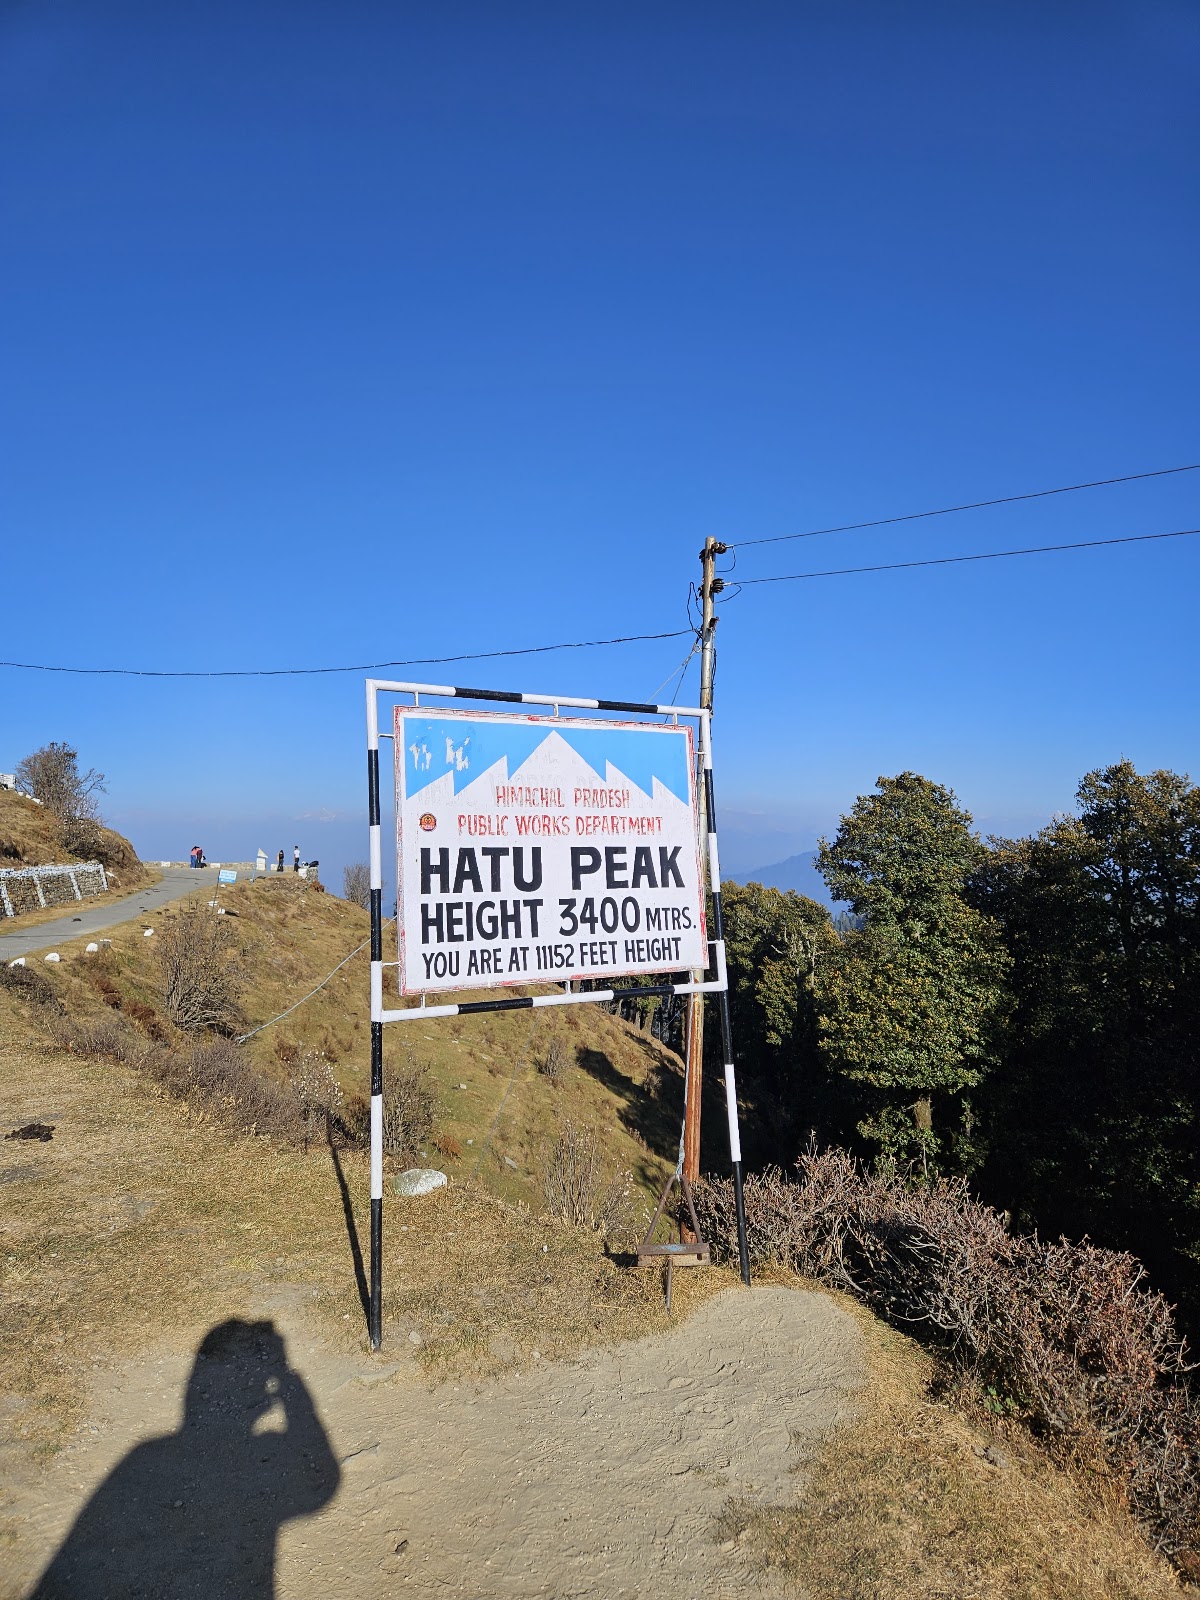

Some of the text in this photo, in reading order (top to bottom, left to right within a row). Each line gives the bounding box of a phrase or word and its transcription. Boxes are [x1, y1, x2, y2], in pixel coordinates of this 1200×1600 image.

[496, 786, 630, 808] HIMACHAL PRADESH
[458, 815, 663, 837] PUBLIC WORKS DEPARTMENT
[420, 846, 685, 895] HATU PEAK
[420, 897, 696, 944] HEIGHT 3400 MTRS.
[422, 937, 682, 979] YOU ARE AT 11152 FEET HEIGHT
